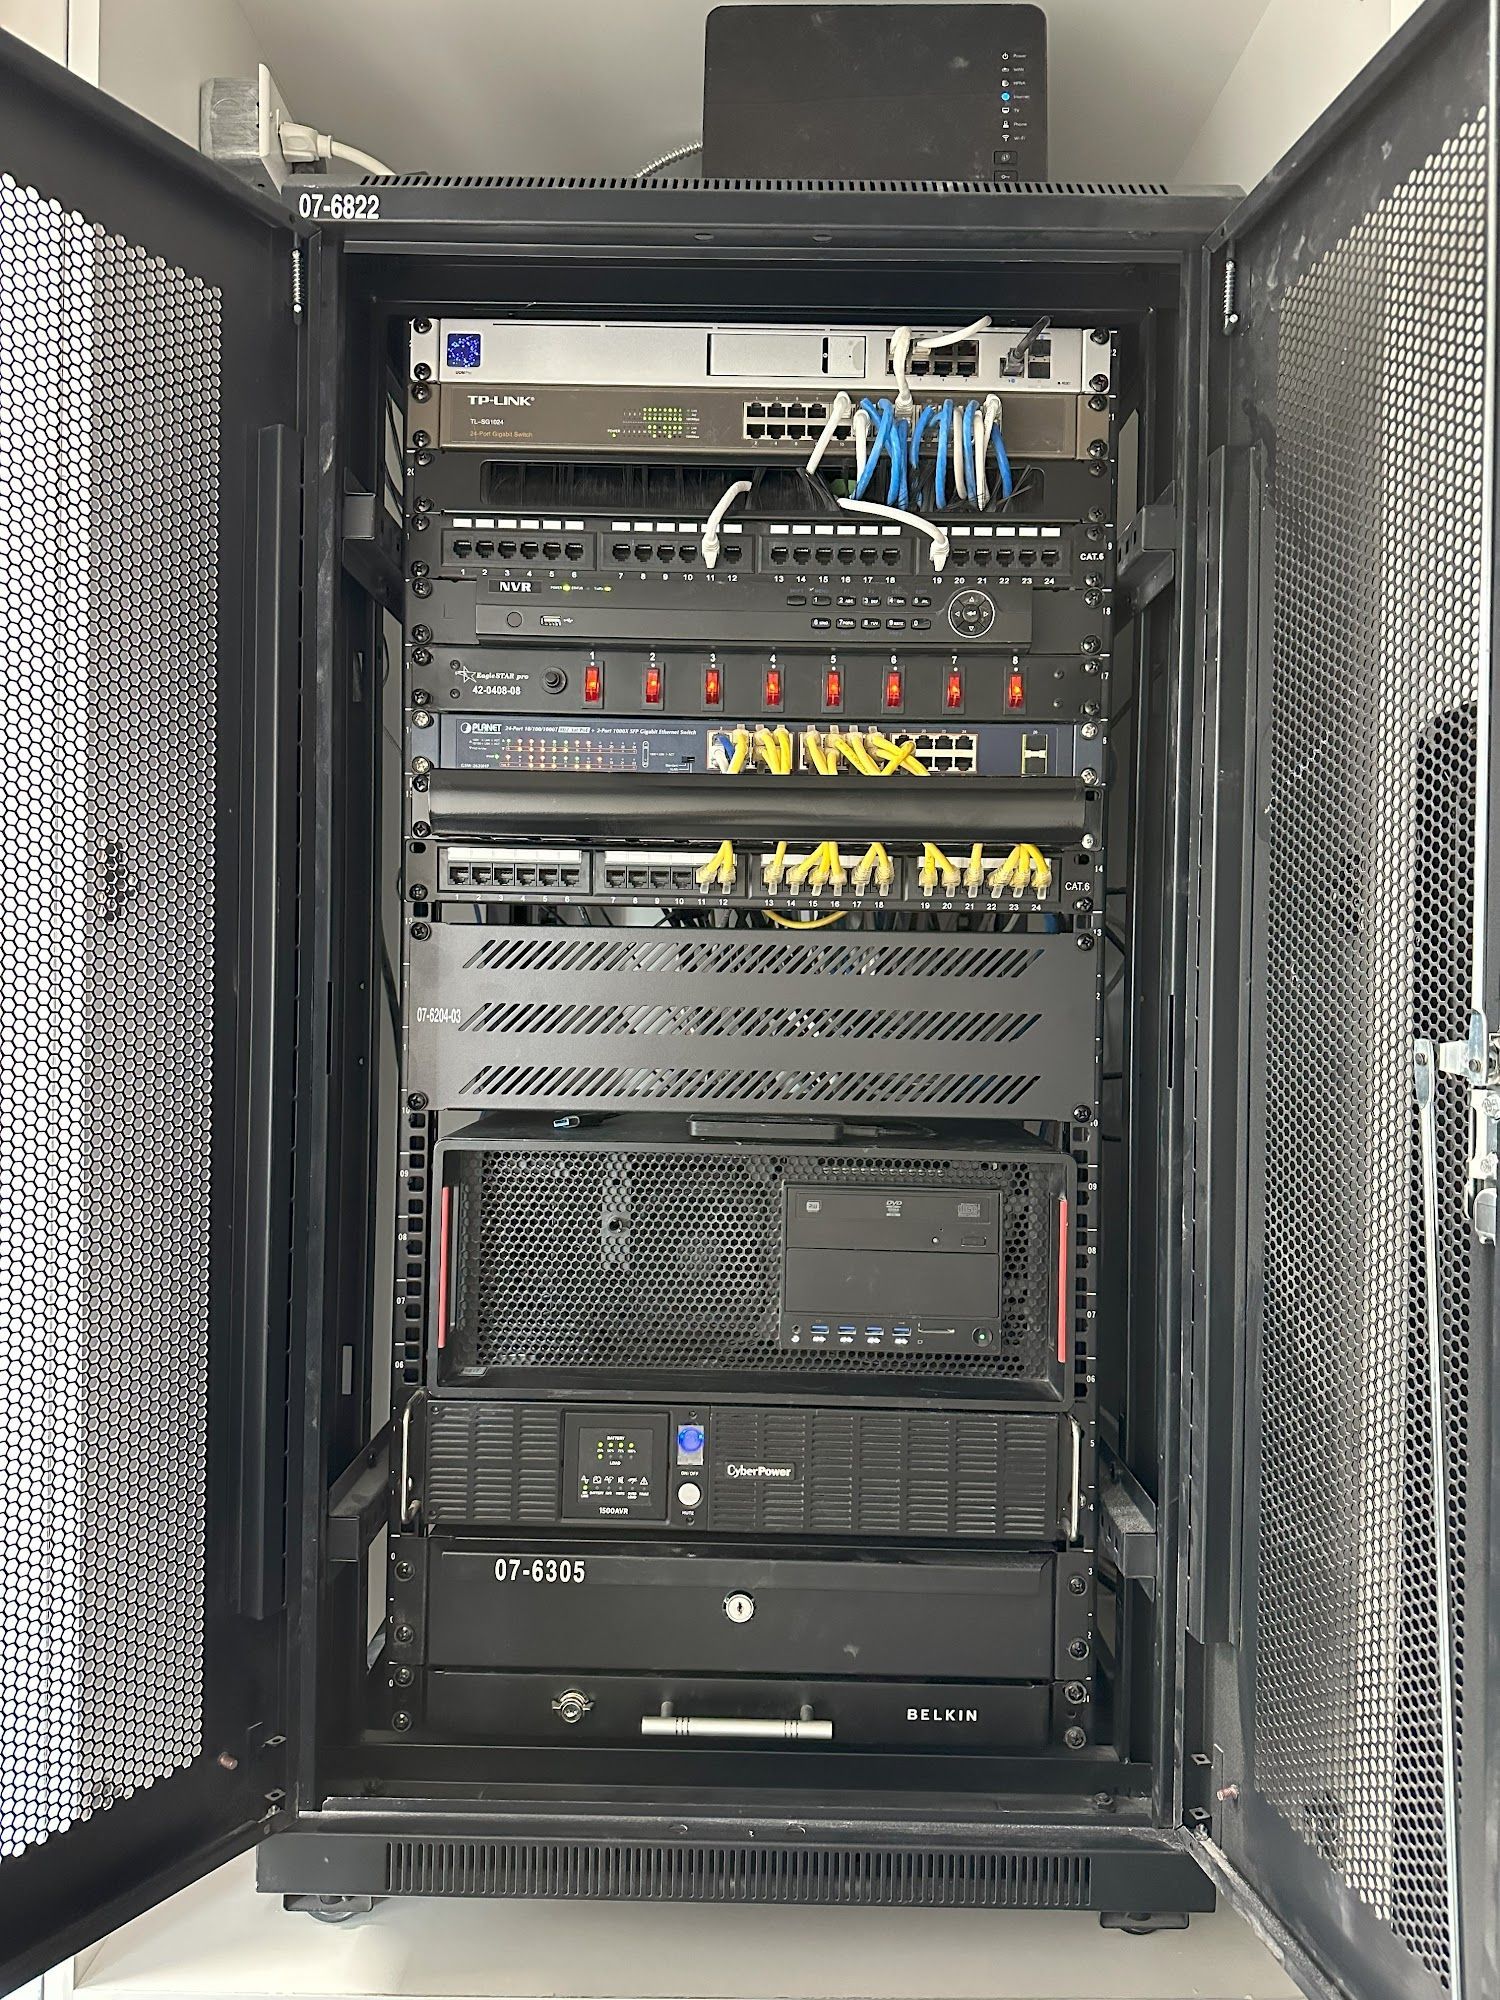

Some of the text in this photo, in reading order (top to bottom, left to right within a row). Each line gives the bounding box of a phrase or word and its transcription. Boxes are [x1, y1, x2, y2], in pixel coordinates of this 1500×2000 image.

[299, 194, 381, 221] 07-6822
[499, 581, 532, 592] NVR
[650, 653, 655, 661] 2
[710, 654, 715, 662] 3
[770, 655, 776, 665] 4
[831, 655, 836, 663] 5
[891, 656, 896, 664] 6
[952, 656, 957, 664] 7
[1013, 656, 1018, 664] 8
[477, 672, 515, 680] EagleSTAR
[472, 685, 521, 695] 42-0408-08
[472, 723, 502, 732] PLANET
[1065, 882, 1090, 891] CAT.6
[498, 894, 504, 902] 3
[718, 898, 728, 906] 12
[417, 1007, 461, 1024] 07-6204-03
[726, 1463, 792, 1478] CyberPower
[599, 1507, 629, 1515] 1500AVR
[495, 1556, 588, 1583] 07-6305
[906, 1707, 979, 1723] BELKIN
